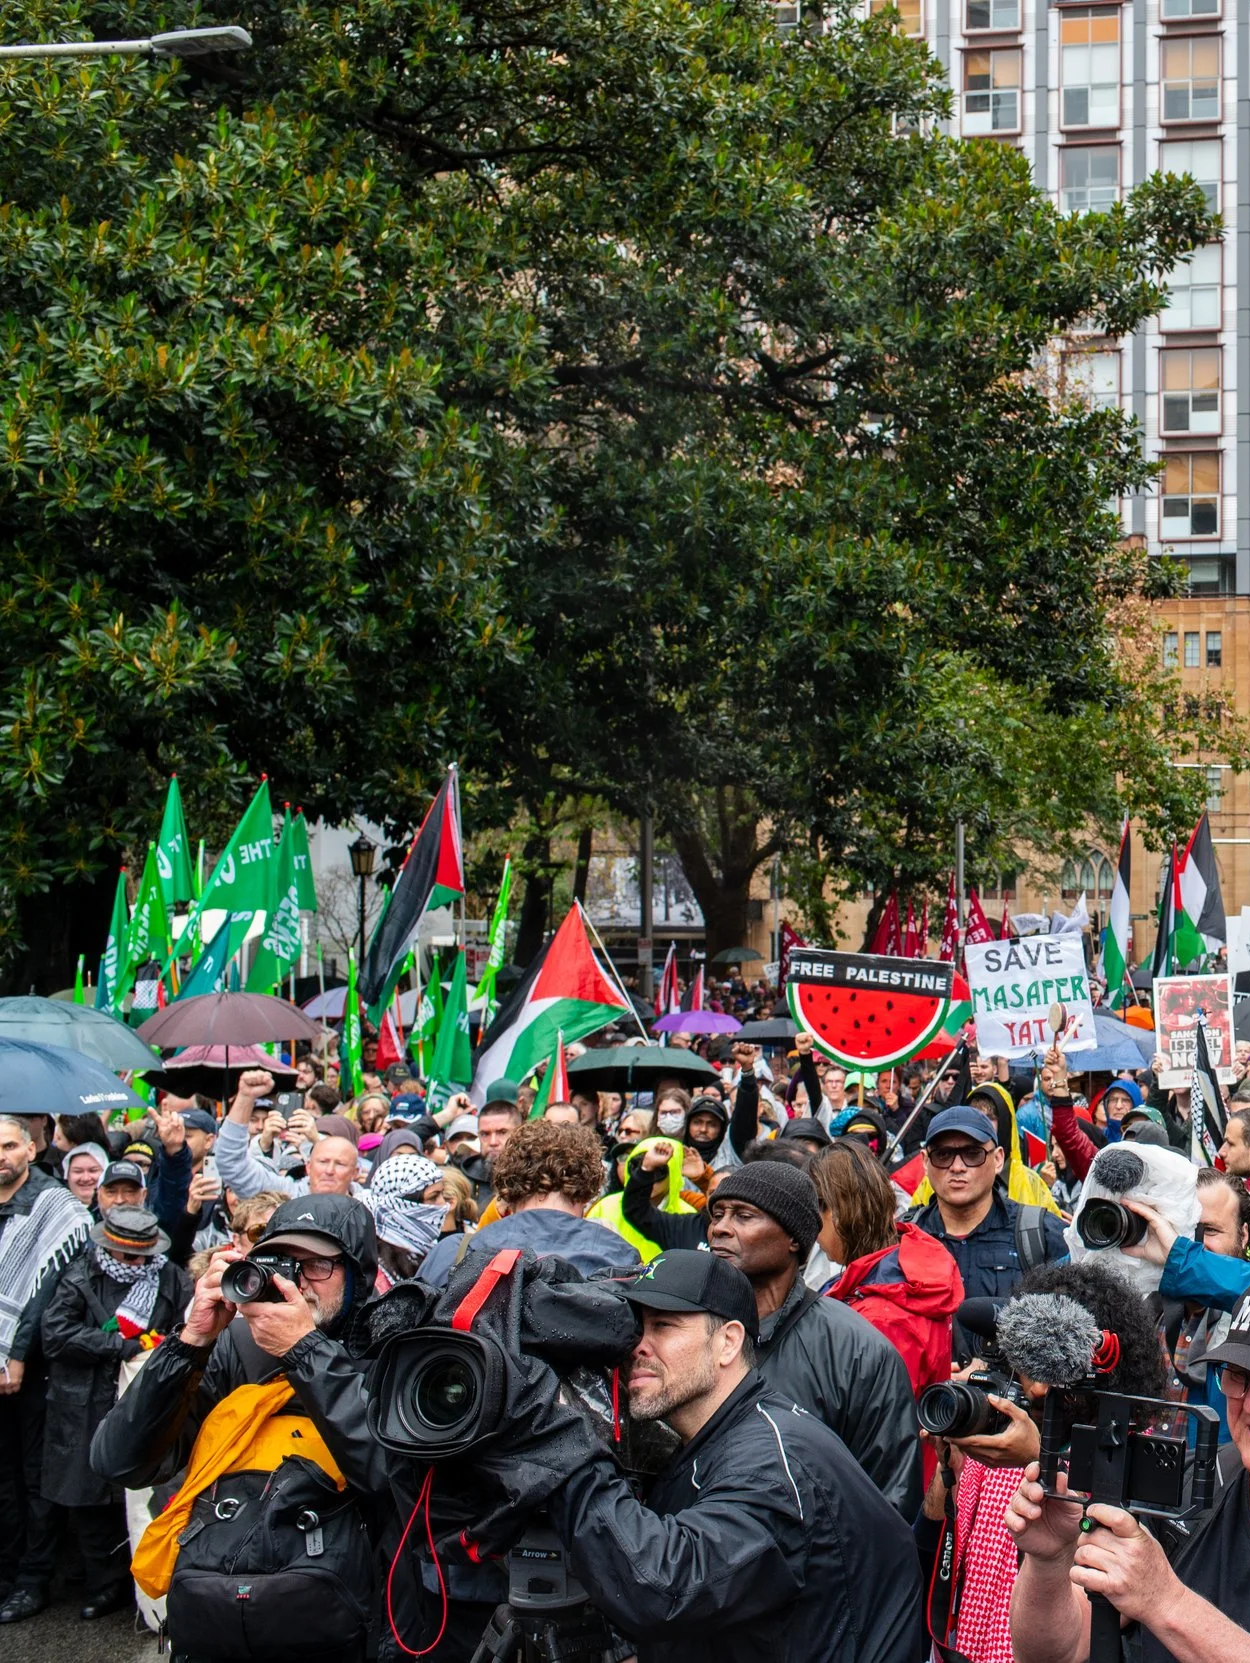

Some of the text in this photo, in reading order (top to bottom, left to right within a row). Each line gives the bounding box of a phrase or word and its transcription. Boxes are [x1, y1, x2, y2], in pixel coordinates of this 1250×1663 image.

[984, 942, 1063, 973] SAVE
[790, 961, 834, 978] FREE
[846, 967, 946, 991] PALESTINE
[972, 976, 1088, 1013] MASAFER
[522, 1550, 547, 1558] Arrow
[940, 1532, 952, 1581] Canon
